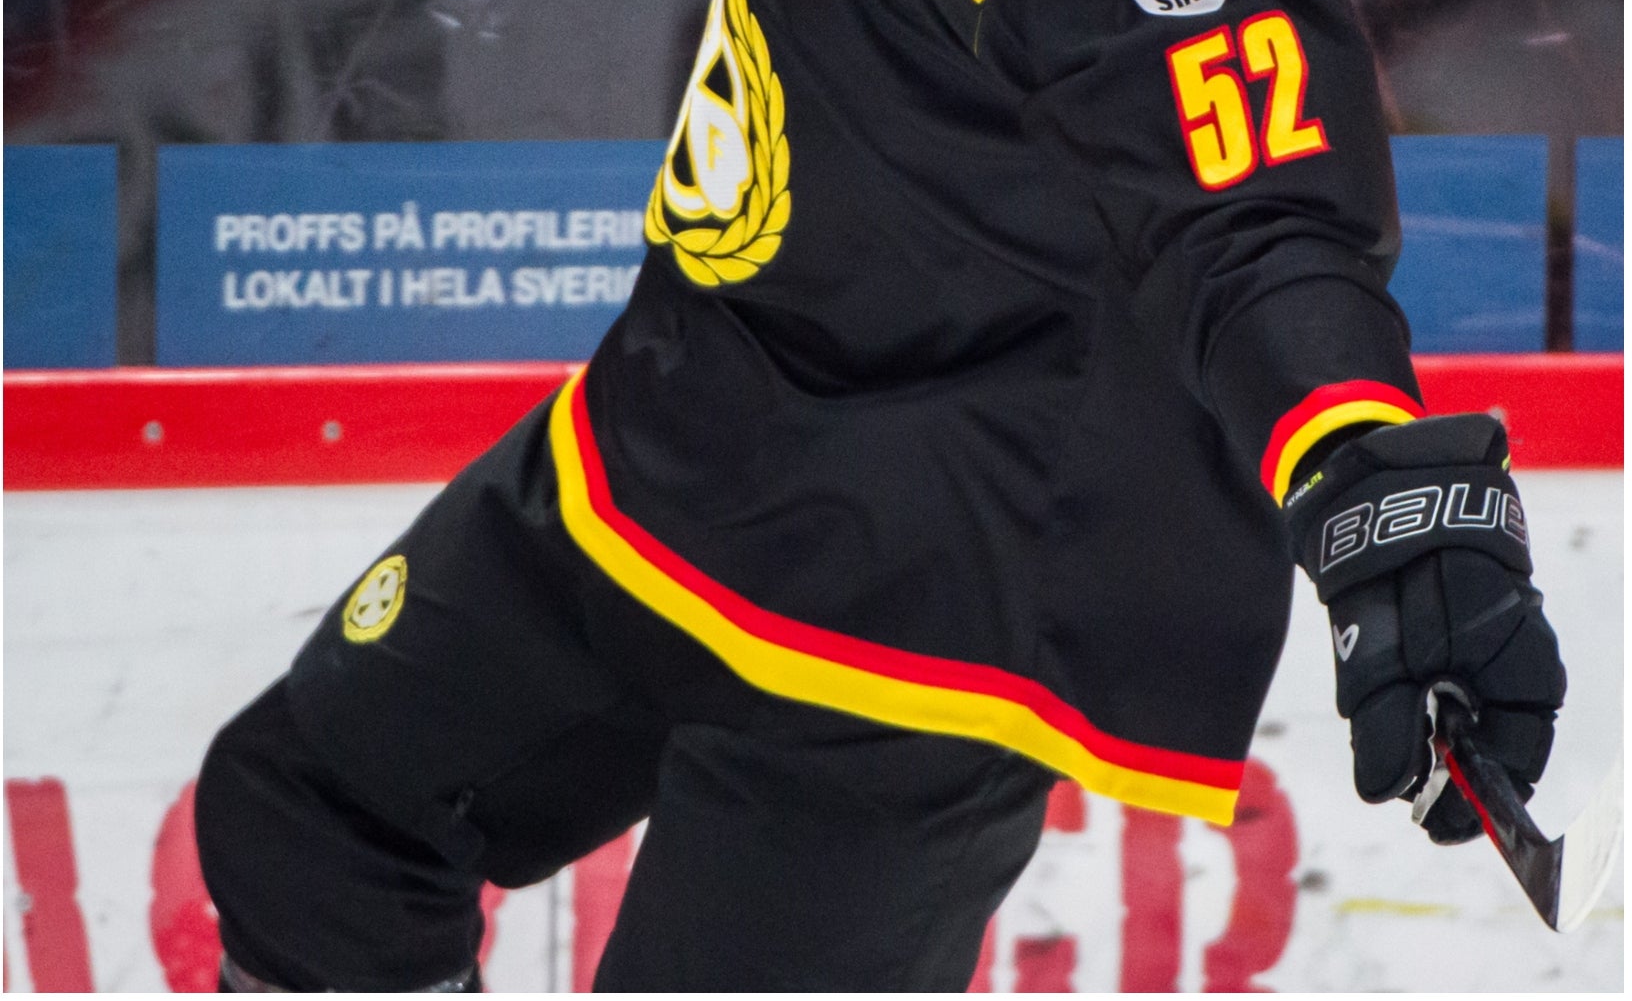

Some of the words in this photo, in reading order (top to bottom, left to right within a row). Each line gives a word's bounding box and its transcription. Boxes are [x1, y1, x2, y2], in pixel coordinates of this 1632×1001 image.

[1164, 9, 1332, 193] 52
[215, 212, 364, 252] PROFFS
[373, 201, 425, 251] PÅ
[223, 269, 372, 310] LOKALT
[380, 268, 394, 307] I
[402, 266, 506, 307] HELA
